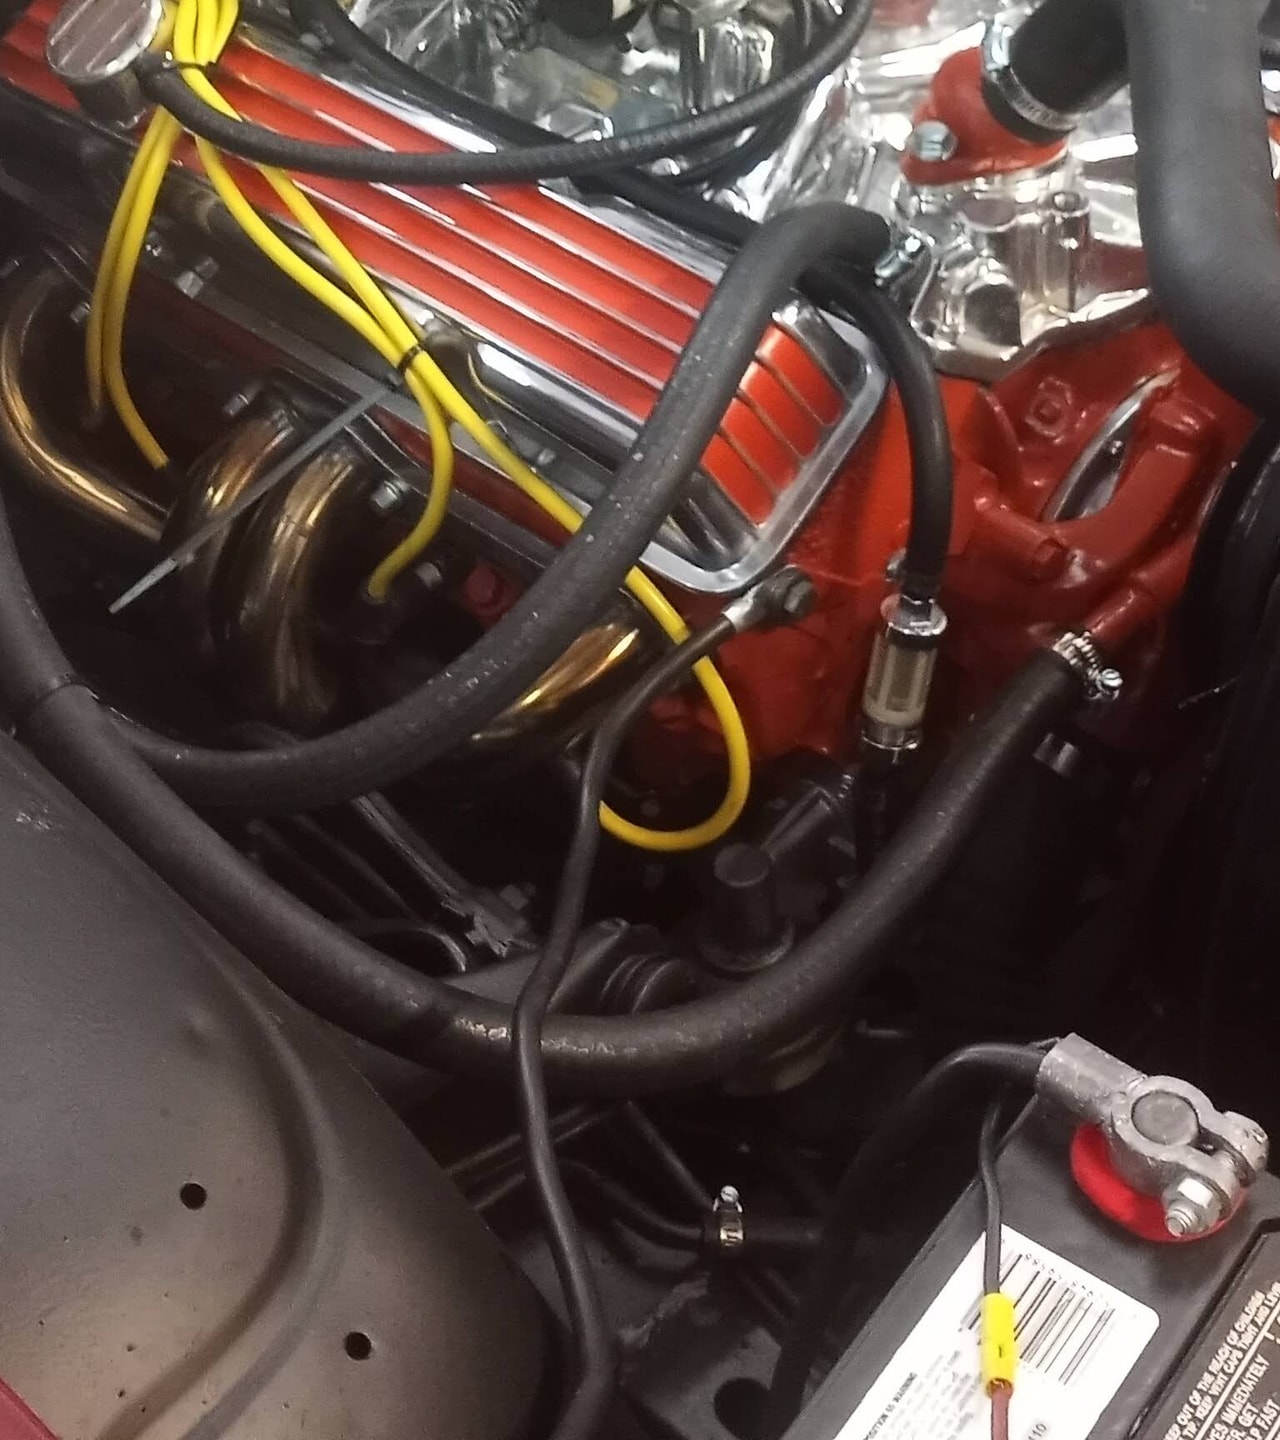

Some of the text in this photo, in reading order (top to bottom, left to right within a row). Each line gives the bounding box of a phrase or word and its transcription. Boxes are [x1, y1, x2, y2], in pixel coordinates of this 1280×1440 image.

[1220, 1353, 1270, 1426] IMMEDIATELY
[1176, 1403, 1195, 1426] OUT
[1237, 1401, 1259, 1427] GET
[1255, 1398, 1280, 1431] FAST
